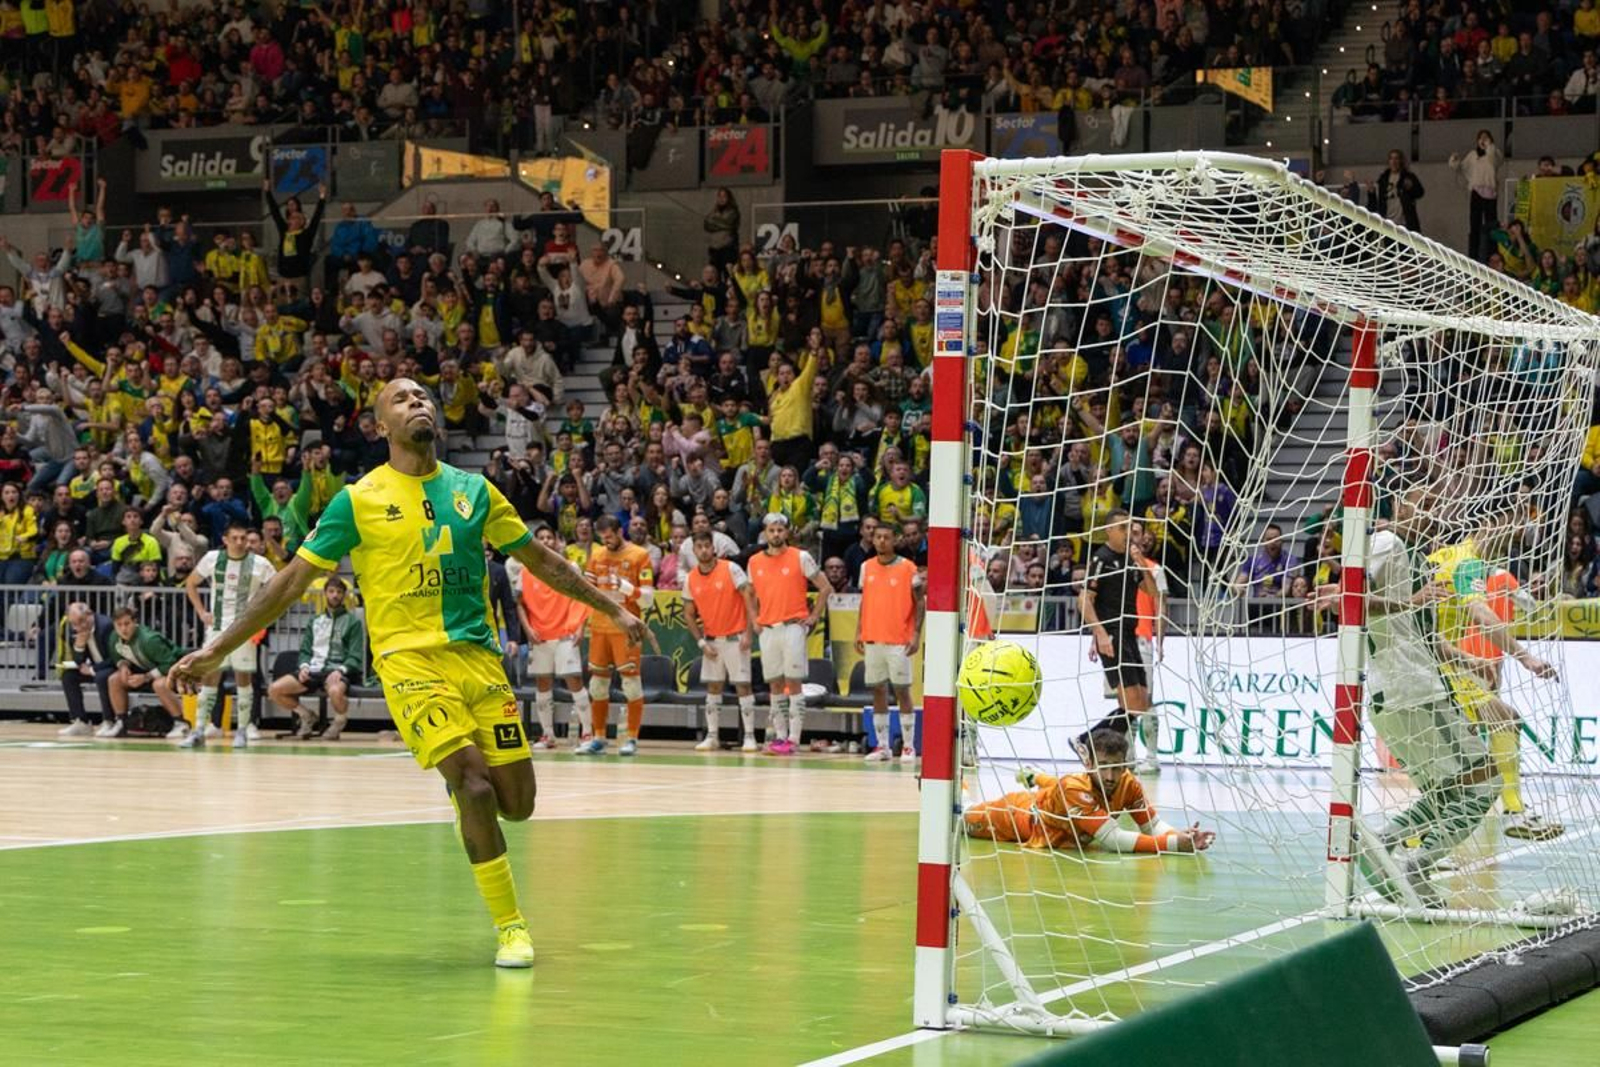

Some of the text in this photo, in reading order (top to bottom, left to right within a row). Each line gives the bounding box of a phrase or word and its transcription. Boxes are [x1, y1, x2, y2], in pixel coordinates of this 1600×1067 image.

[708, 128, 748, 141] Sector
[842, 104, 975, 150] Salida 10
[995, 116, 1035, 129] Sector
[160, 151, 238, 178] Salida
[271, 148, 308, 161] Sector
[708, 127, 769, 177] 24
[601, 227, 643, 263] 24
[422, 499, 436, 521] 8
[409, 558, 470, 590] Jaén
[1206, 667, 1321, 694] GARZÓN
[499, 726, 518, 742] LZ
[1138, 699, 1336, 758] GREEN
